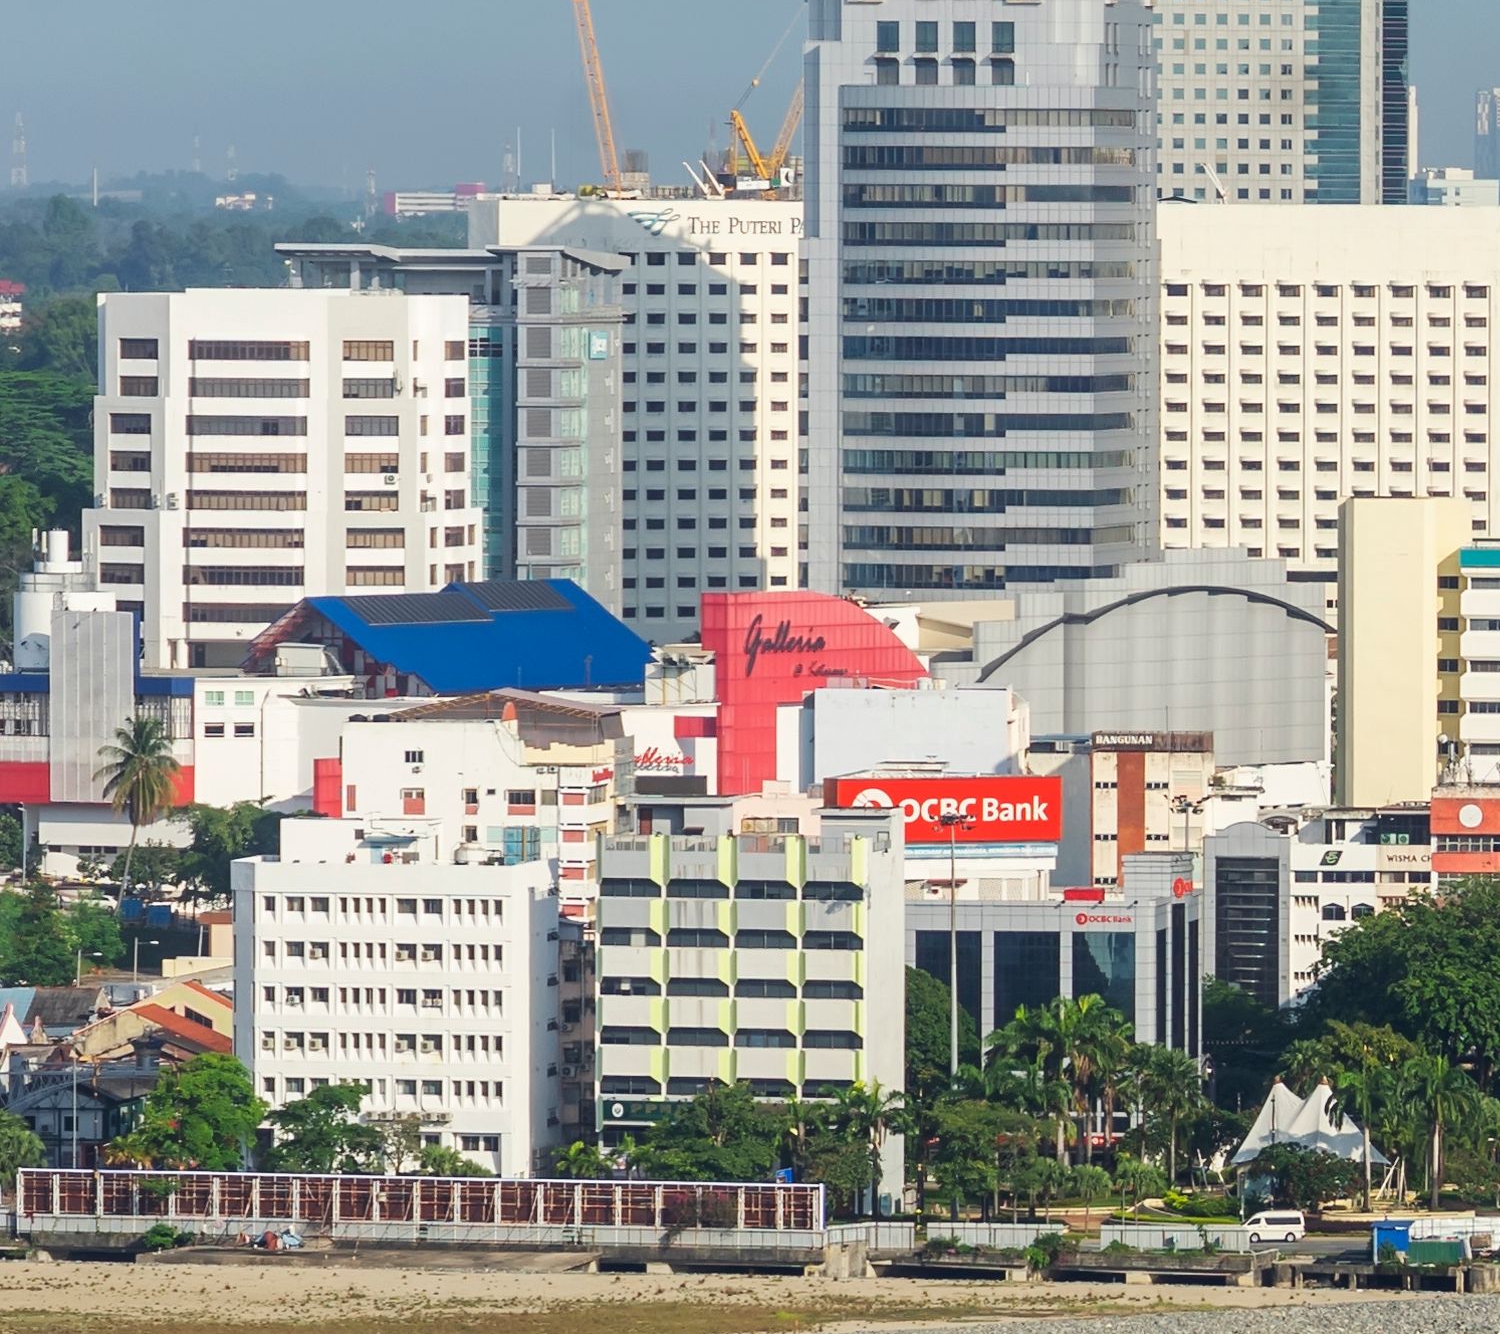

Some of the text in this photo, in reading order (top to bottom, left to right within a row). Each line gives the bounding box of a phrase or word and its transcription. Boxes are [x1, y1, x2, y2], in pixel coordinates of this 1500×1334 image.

[744, 613, 826, 677] Galleria
[1096, 735, 1153, 744] BANGUNAN
[982, 795, 1048, 822] Bank
